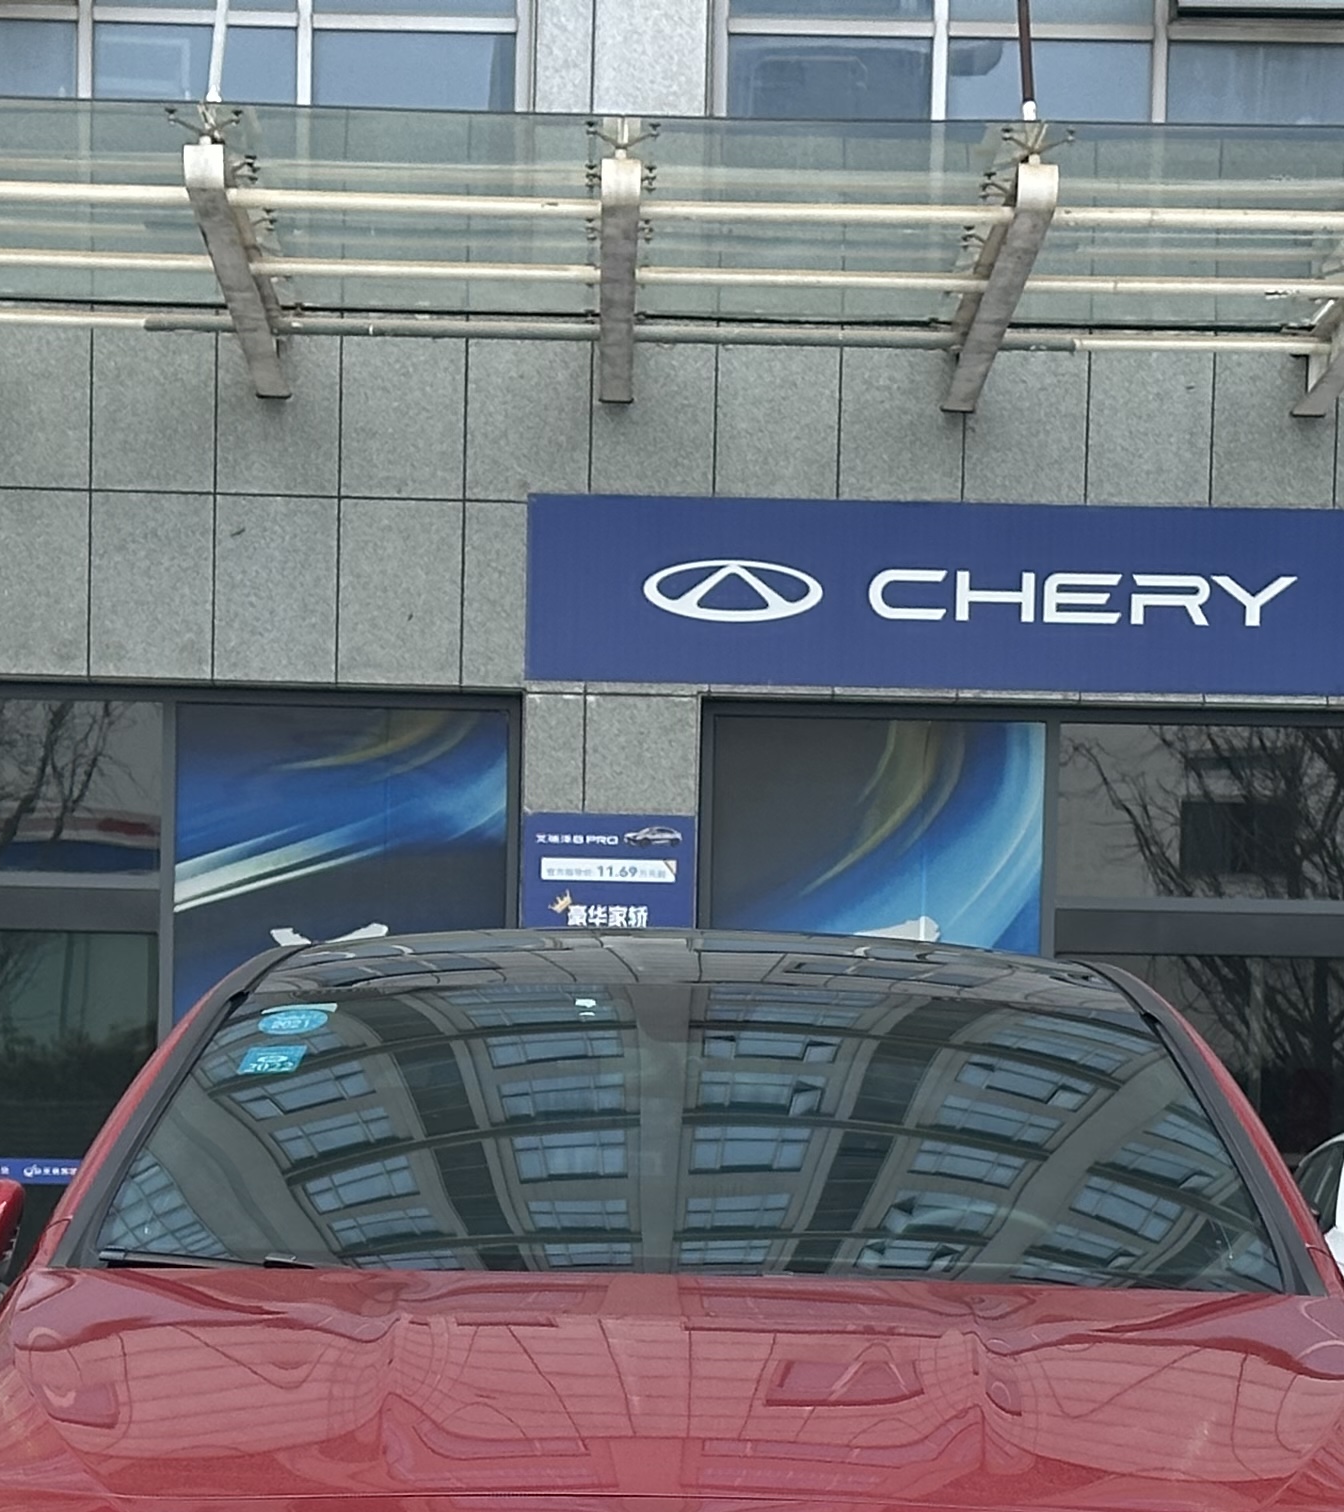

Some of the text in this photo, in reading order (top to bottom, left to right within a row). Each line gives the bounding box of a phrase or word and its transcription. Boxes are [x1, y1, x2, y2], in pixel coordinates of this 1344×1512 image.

[868, 568, 1298, 627] CHERY
[586, 834, 619, 846] PRO
[596, 865, 638, 878] 11.69
[567, 904, 649, 928] 豪华家轿
